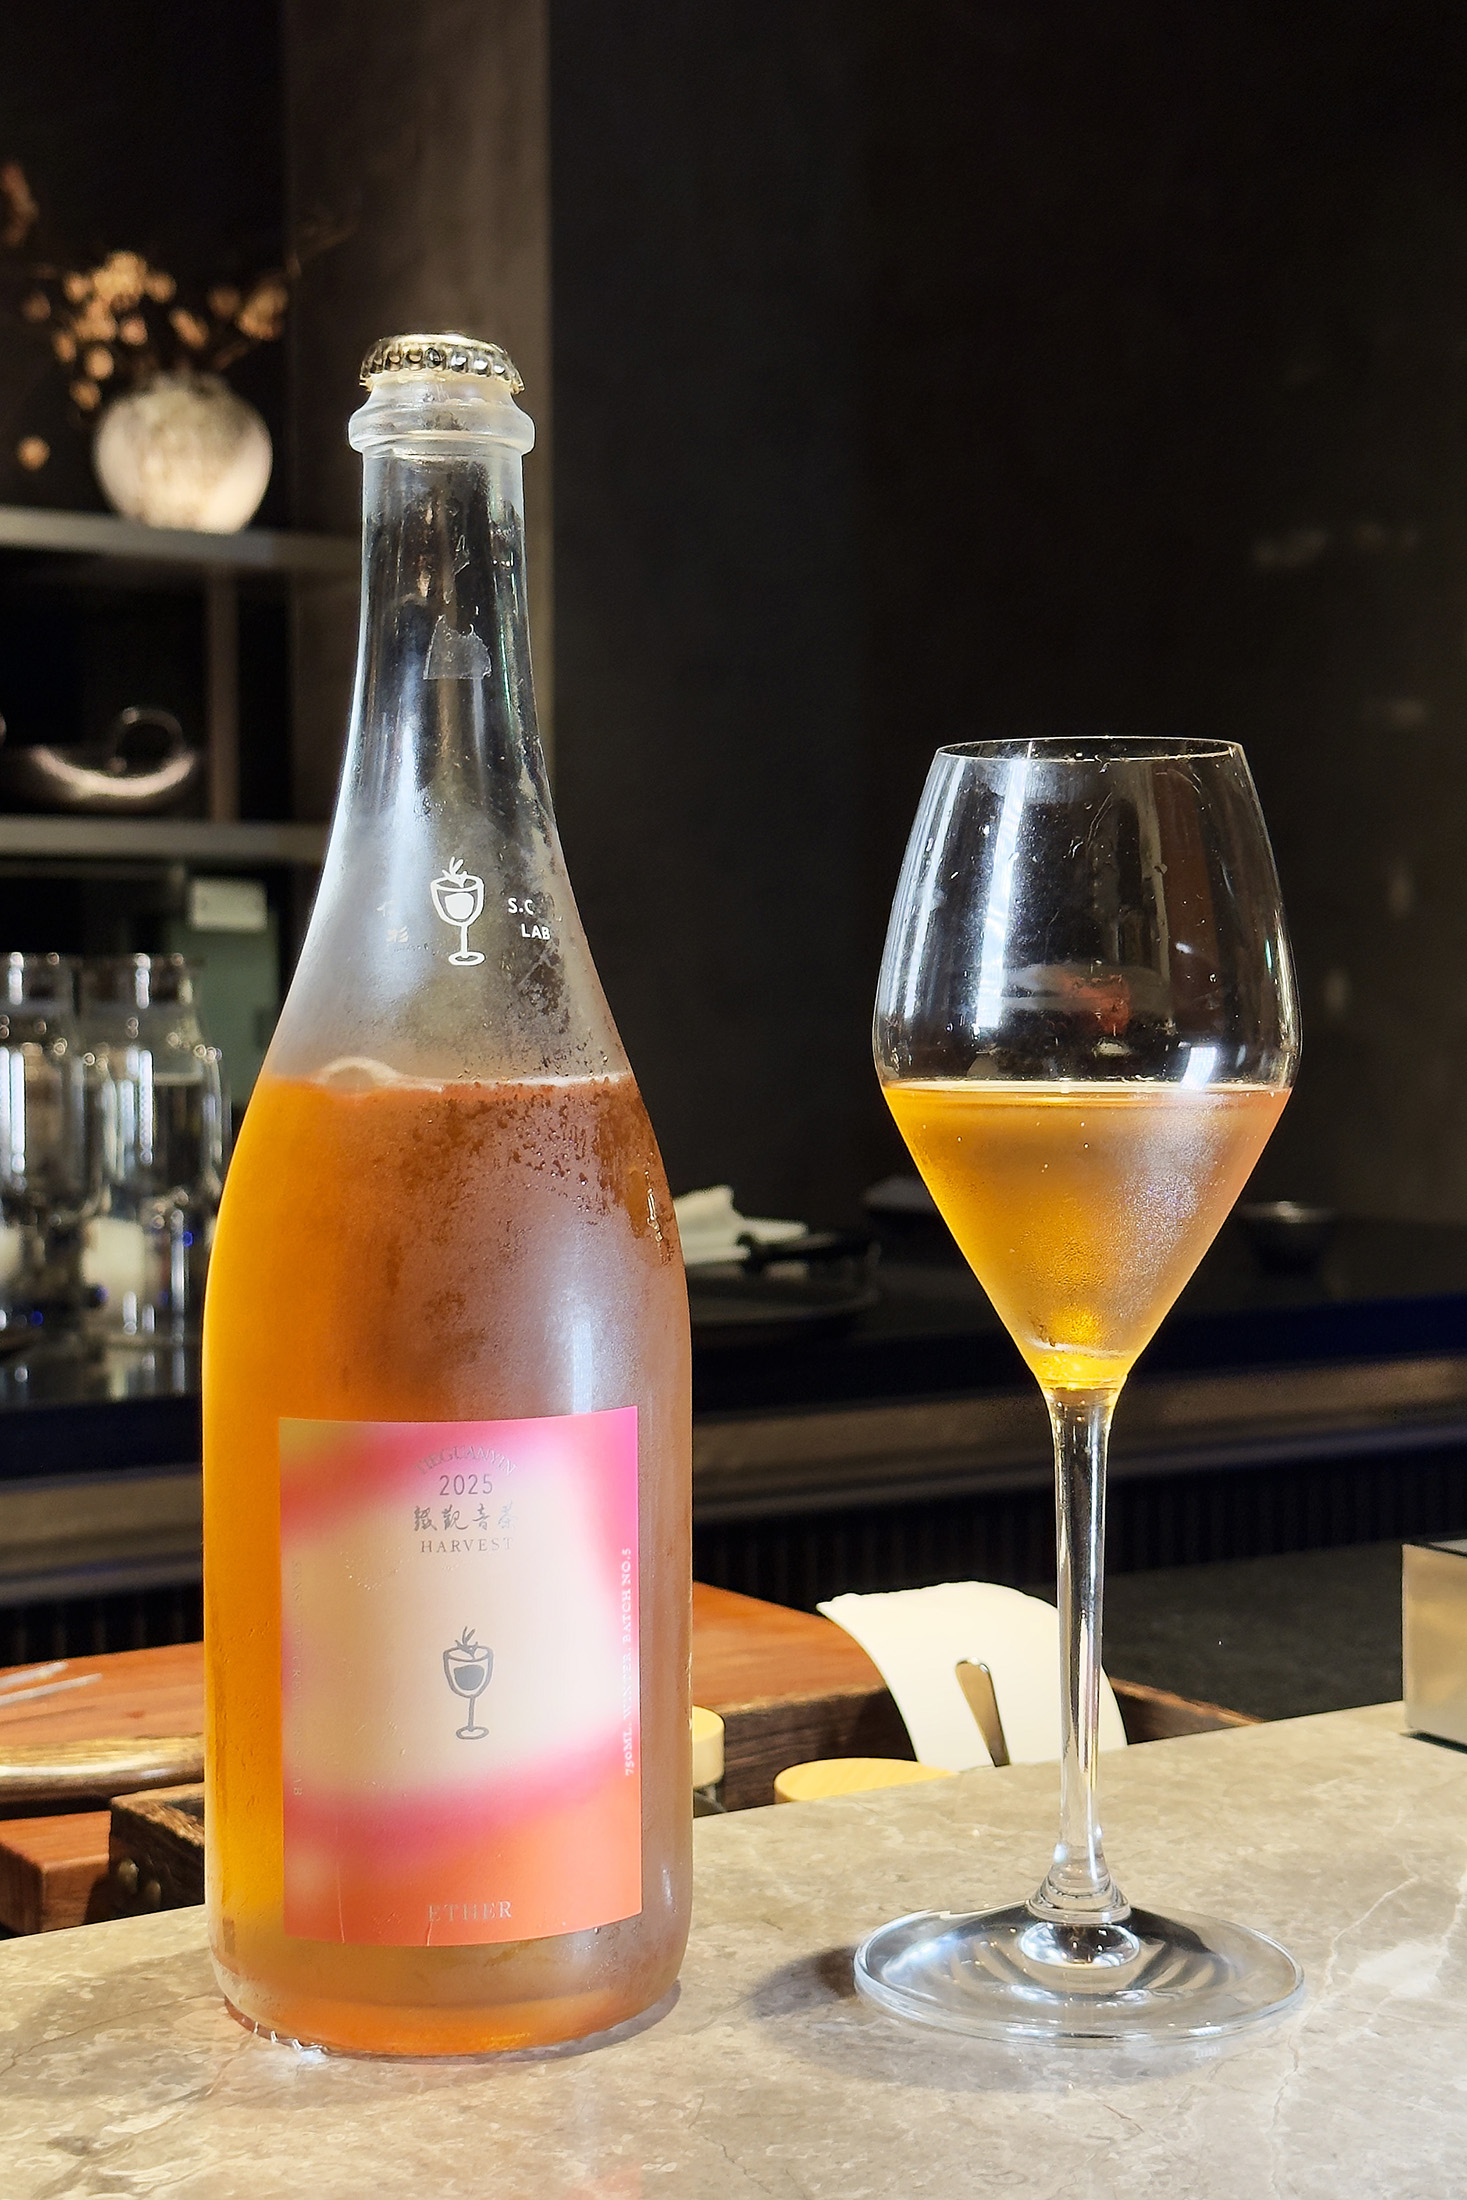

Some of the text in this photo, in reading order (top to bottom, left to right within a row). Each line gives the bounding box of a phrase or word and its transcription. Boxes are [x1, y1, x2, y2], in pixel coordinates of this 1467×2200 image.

[521, 923, 551, 941] LAB
[414, 1445, 517, 1475] TIEGUANYIN
[439, 1473, 494, 1496] 2025
[420, 1537, 513, 1554] HARVEST
[621, 1547, 632, 1586] NO.5
[622, 1588, 632, 1644] BATCH
[427, 1900, 512, 1921] ETHER
